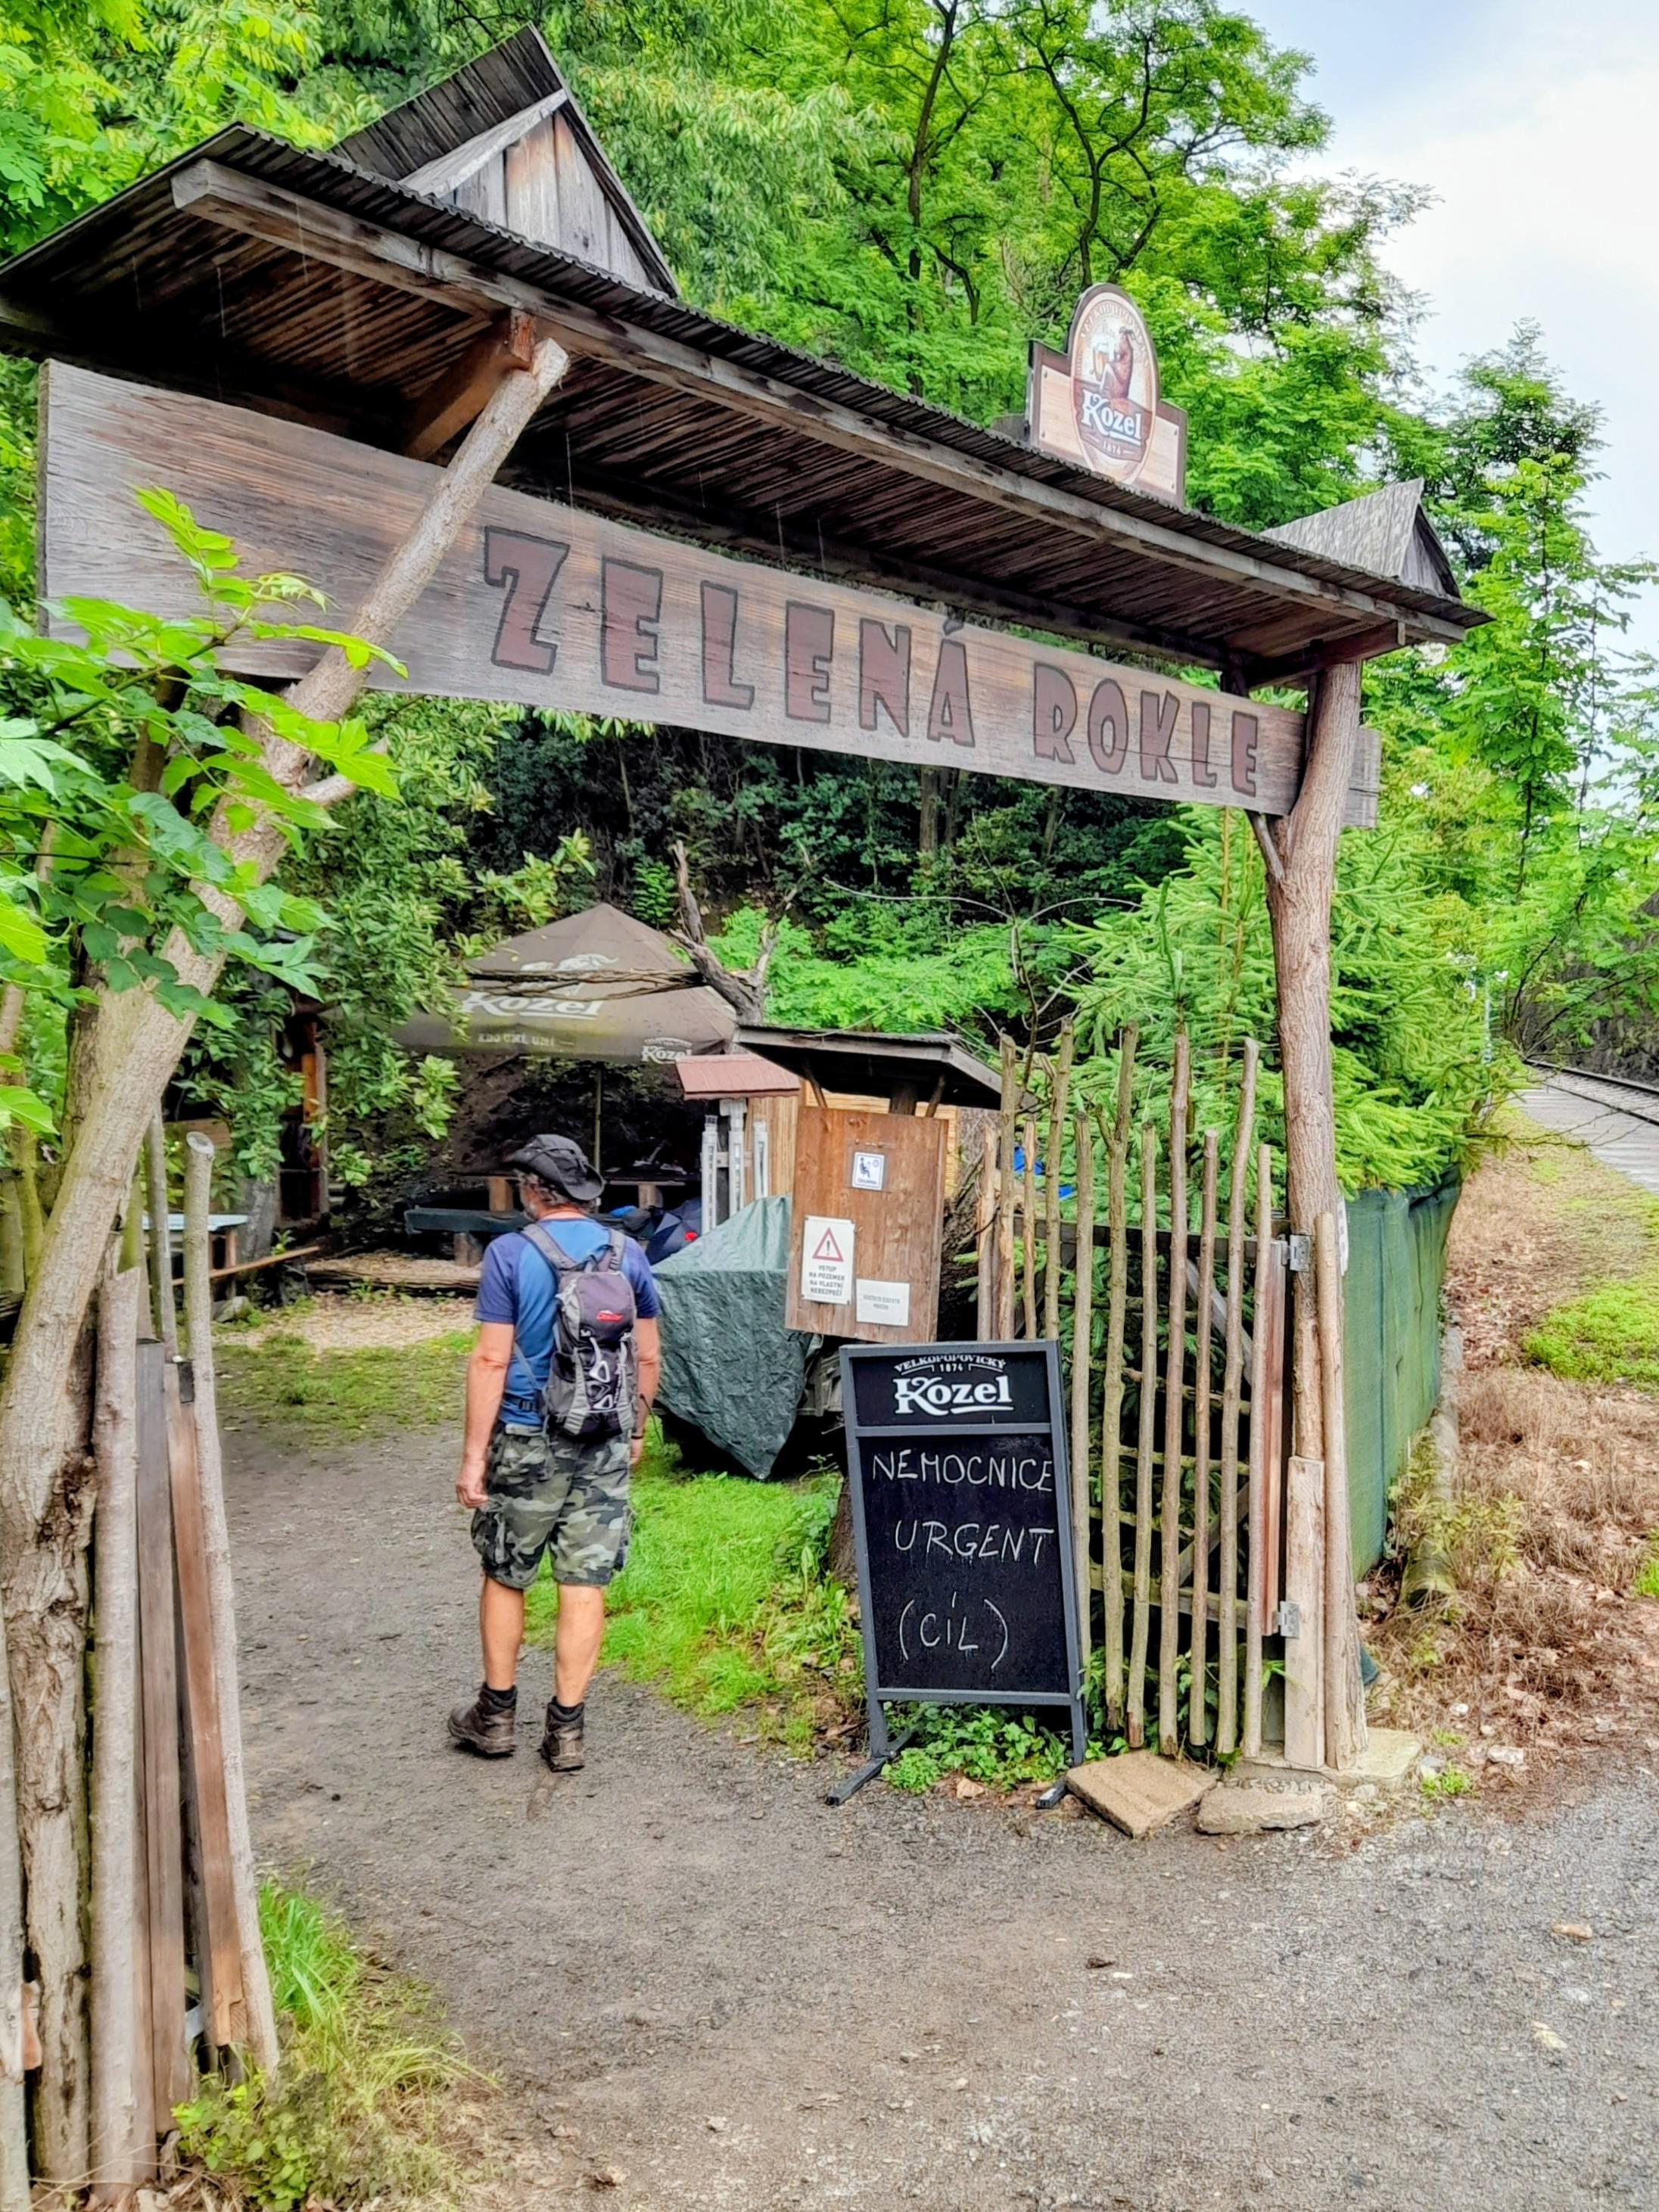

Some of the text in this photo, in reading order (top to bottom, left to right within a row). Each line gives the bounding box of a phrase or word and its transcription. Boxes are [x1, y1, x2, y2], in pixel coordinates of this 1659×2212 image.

[1081, 389, 1141, 442] Kozel
[483, 525, 1259, 798] ZELENÁ ROKLE
[462, 990, 603, 1018] Kozel
[940, 1364, 963, 1373] 1874
[892, 1375, 1013, 1416] Kozel
[873, 1449, 1053, 1492] NEMOCNICE
[895, 1520, 1054, 1565] URGENT
